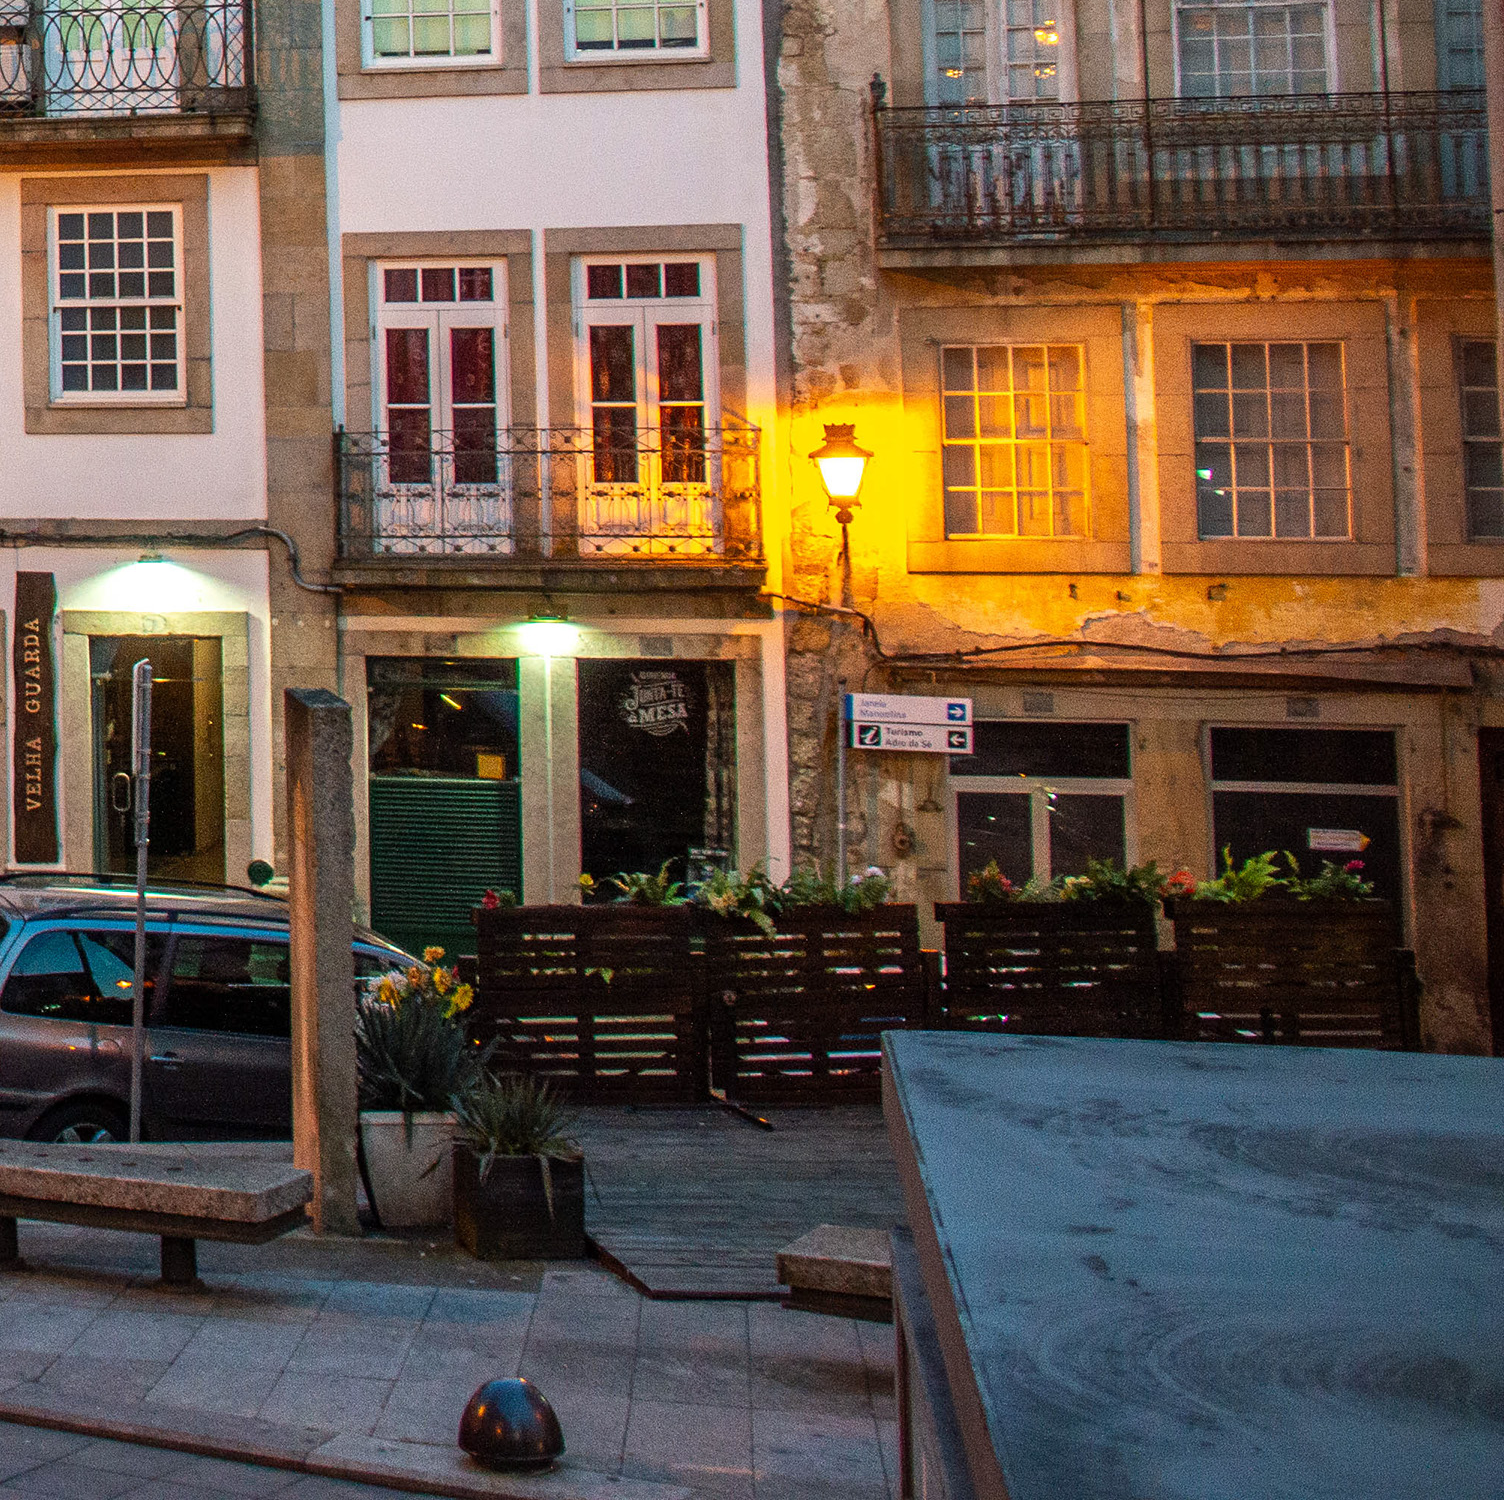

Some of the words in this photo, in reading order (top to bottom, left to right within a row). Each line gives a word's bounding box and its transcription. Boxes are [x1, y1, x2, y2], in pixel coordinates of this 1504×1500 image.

[23, 617, 41, 714] GUARDA
[886, 726, 923, 737] Turismo
[25, 736, 42, 812] VELHA
